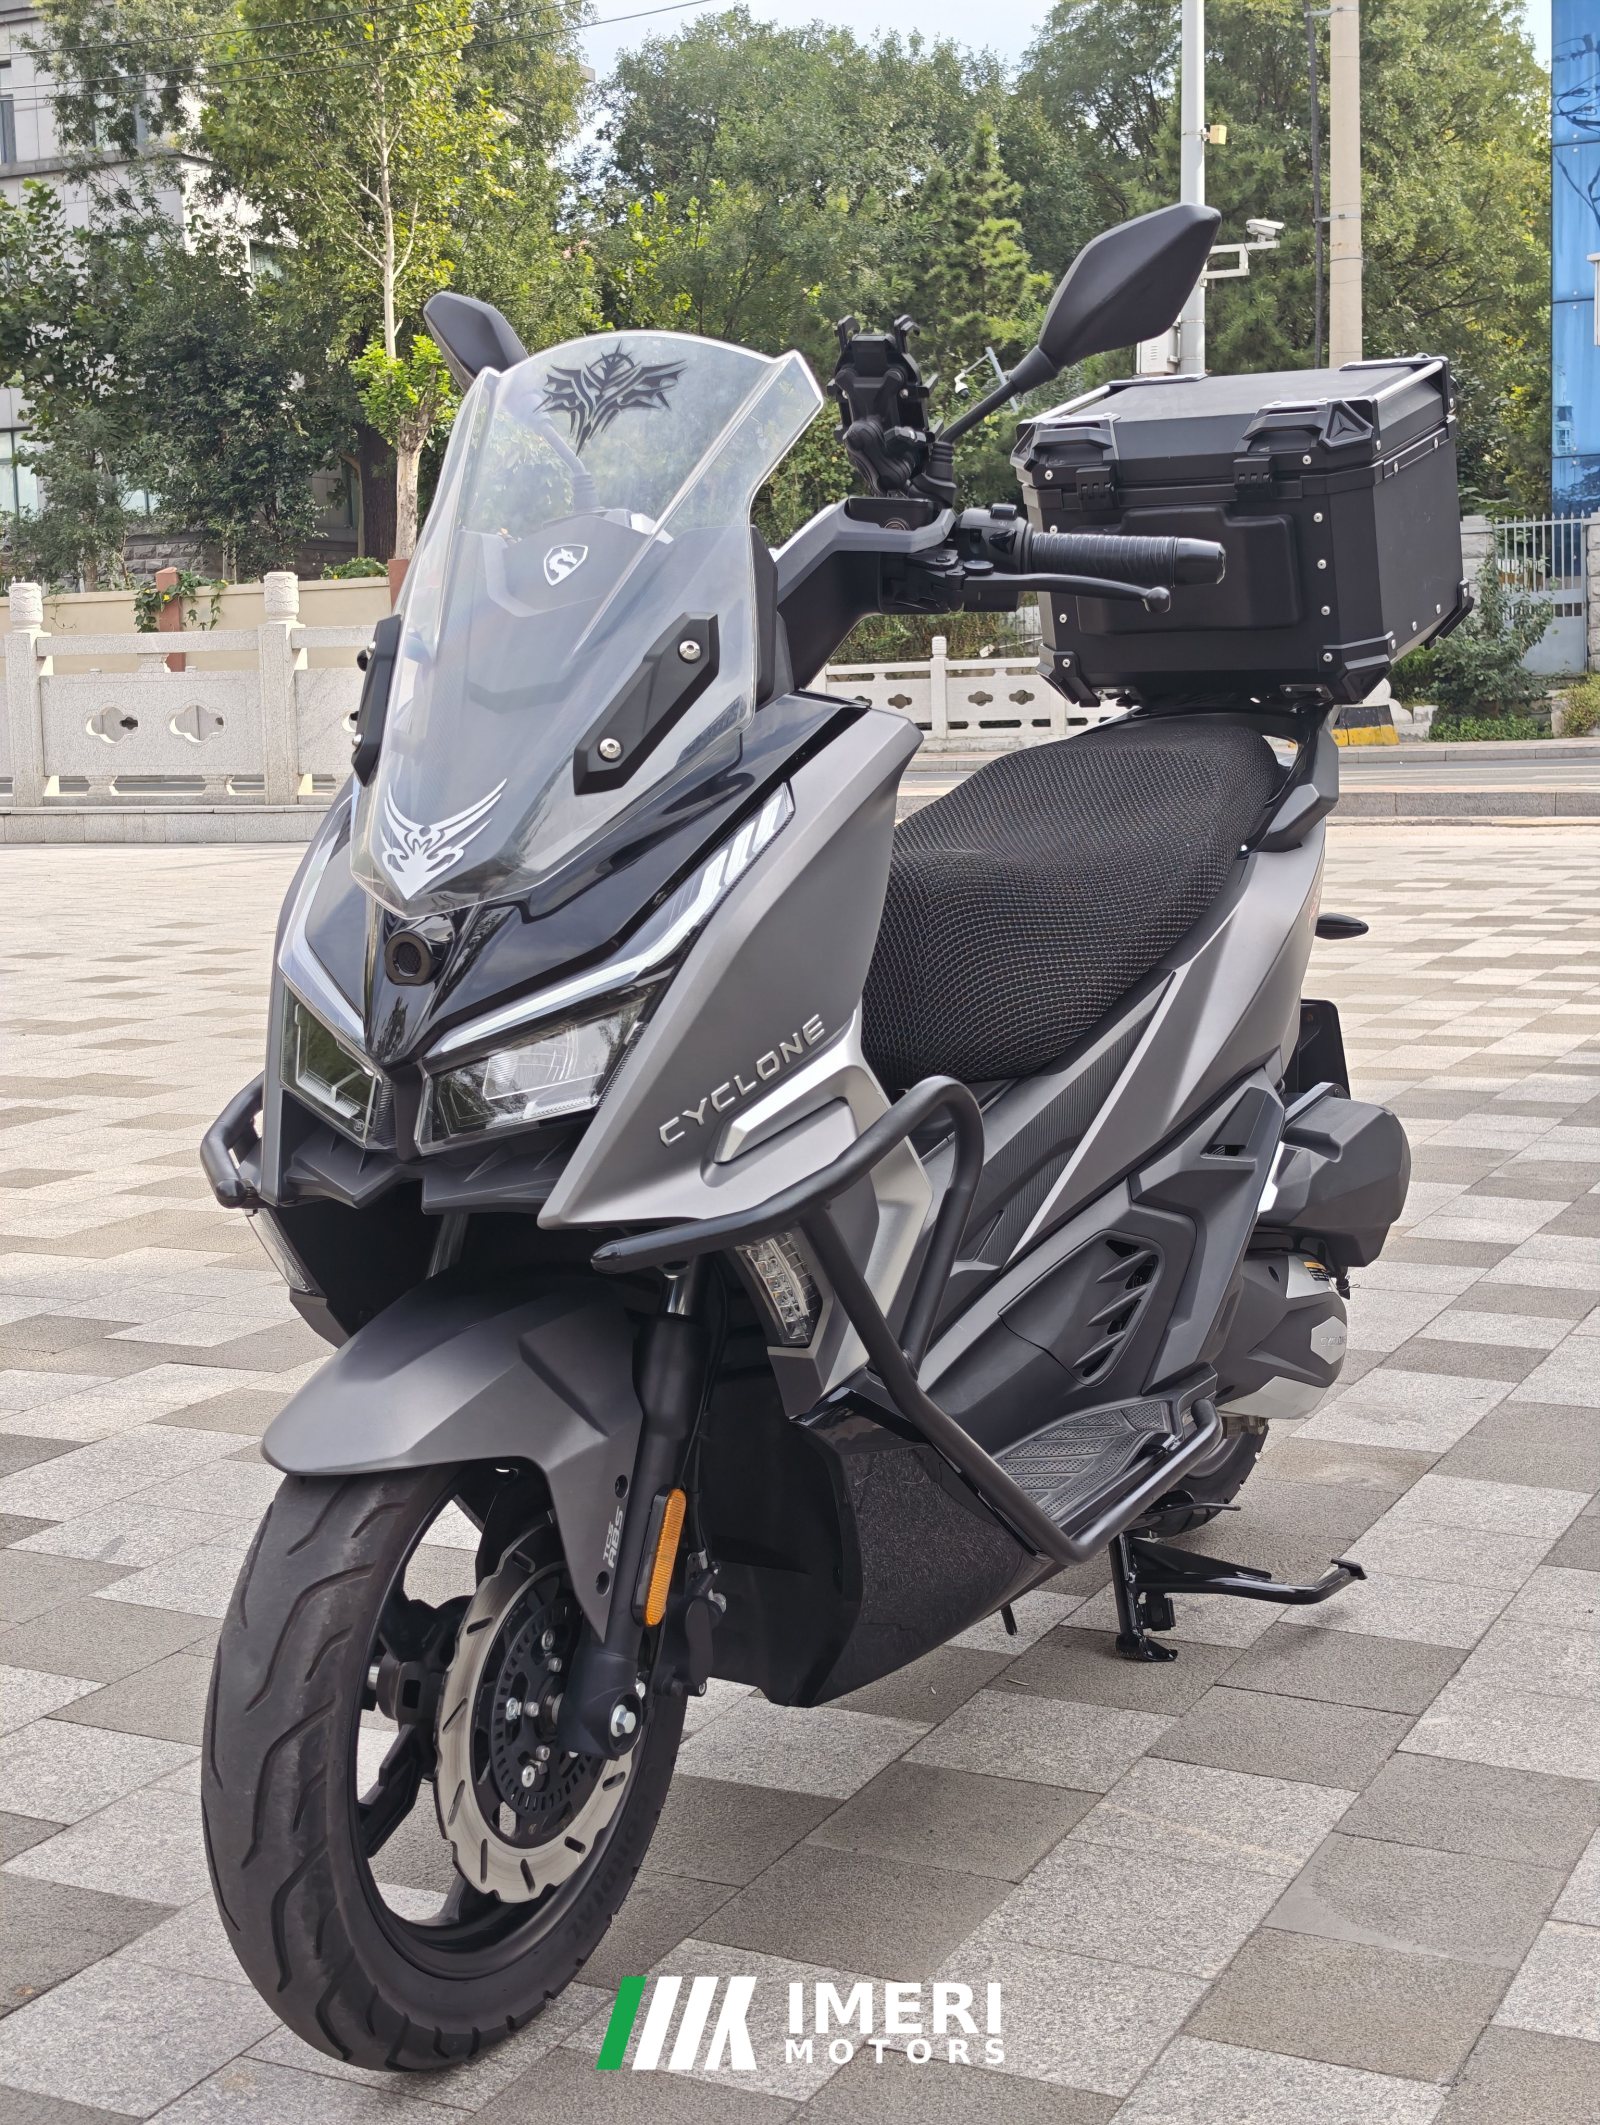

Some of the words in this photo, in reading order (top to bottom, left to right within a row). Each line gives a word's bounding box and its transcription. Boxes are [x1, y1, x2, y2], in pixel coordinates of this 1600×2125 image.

[659, 1013, 825, 1147] CYCLONE
[603, 1521, 614, 1560] TCS
[608, 1505, 623, 1568] ABS
